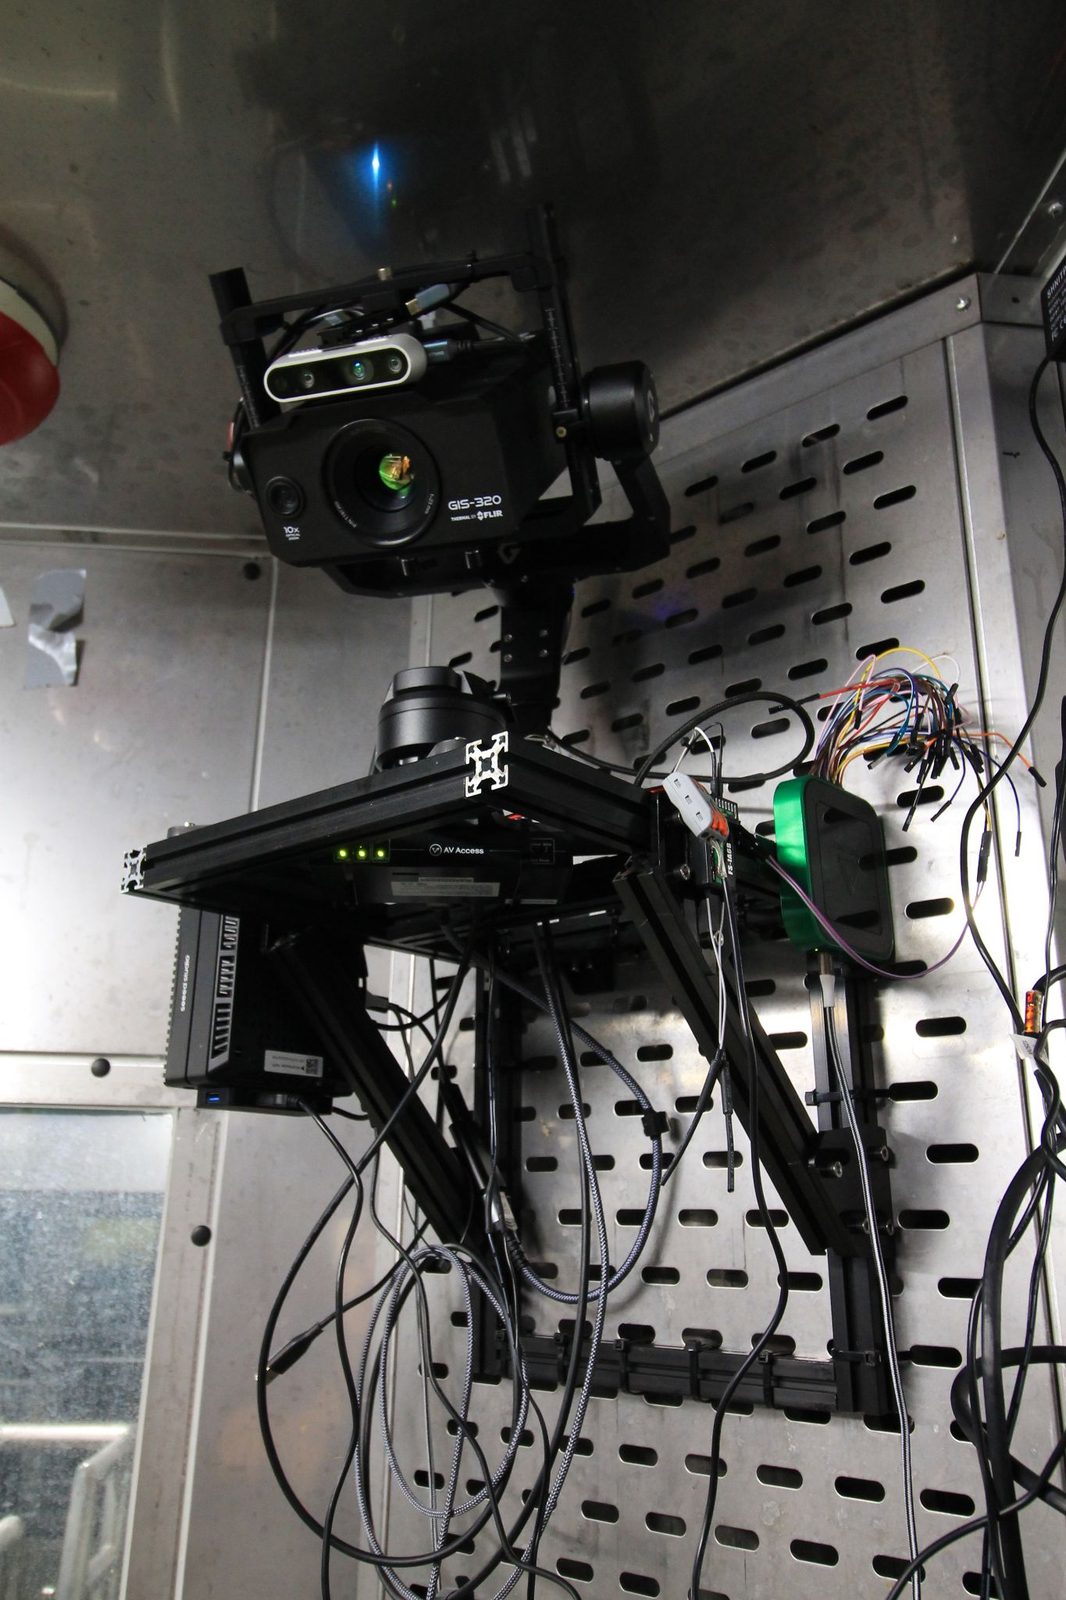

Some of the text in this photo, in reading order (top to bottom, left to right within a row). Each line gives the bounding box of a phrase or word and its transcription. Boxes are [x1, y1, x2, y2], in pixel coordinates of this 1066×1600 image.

[448, 495, 502, 511] GIS-320
[483, 510, 503, 519] FLIR
[443, 846, 485, 855] AV Access
[183, 954, 191, 982] studio
